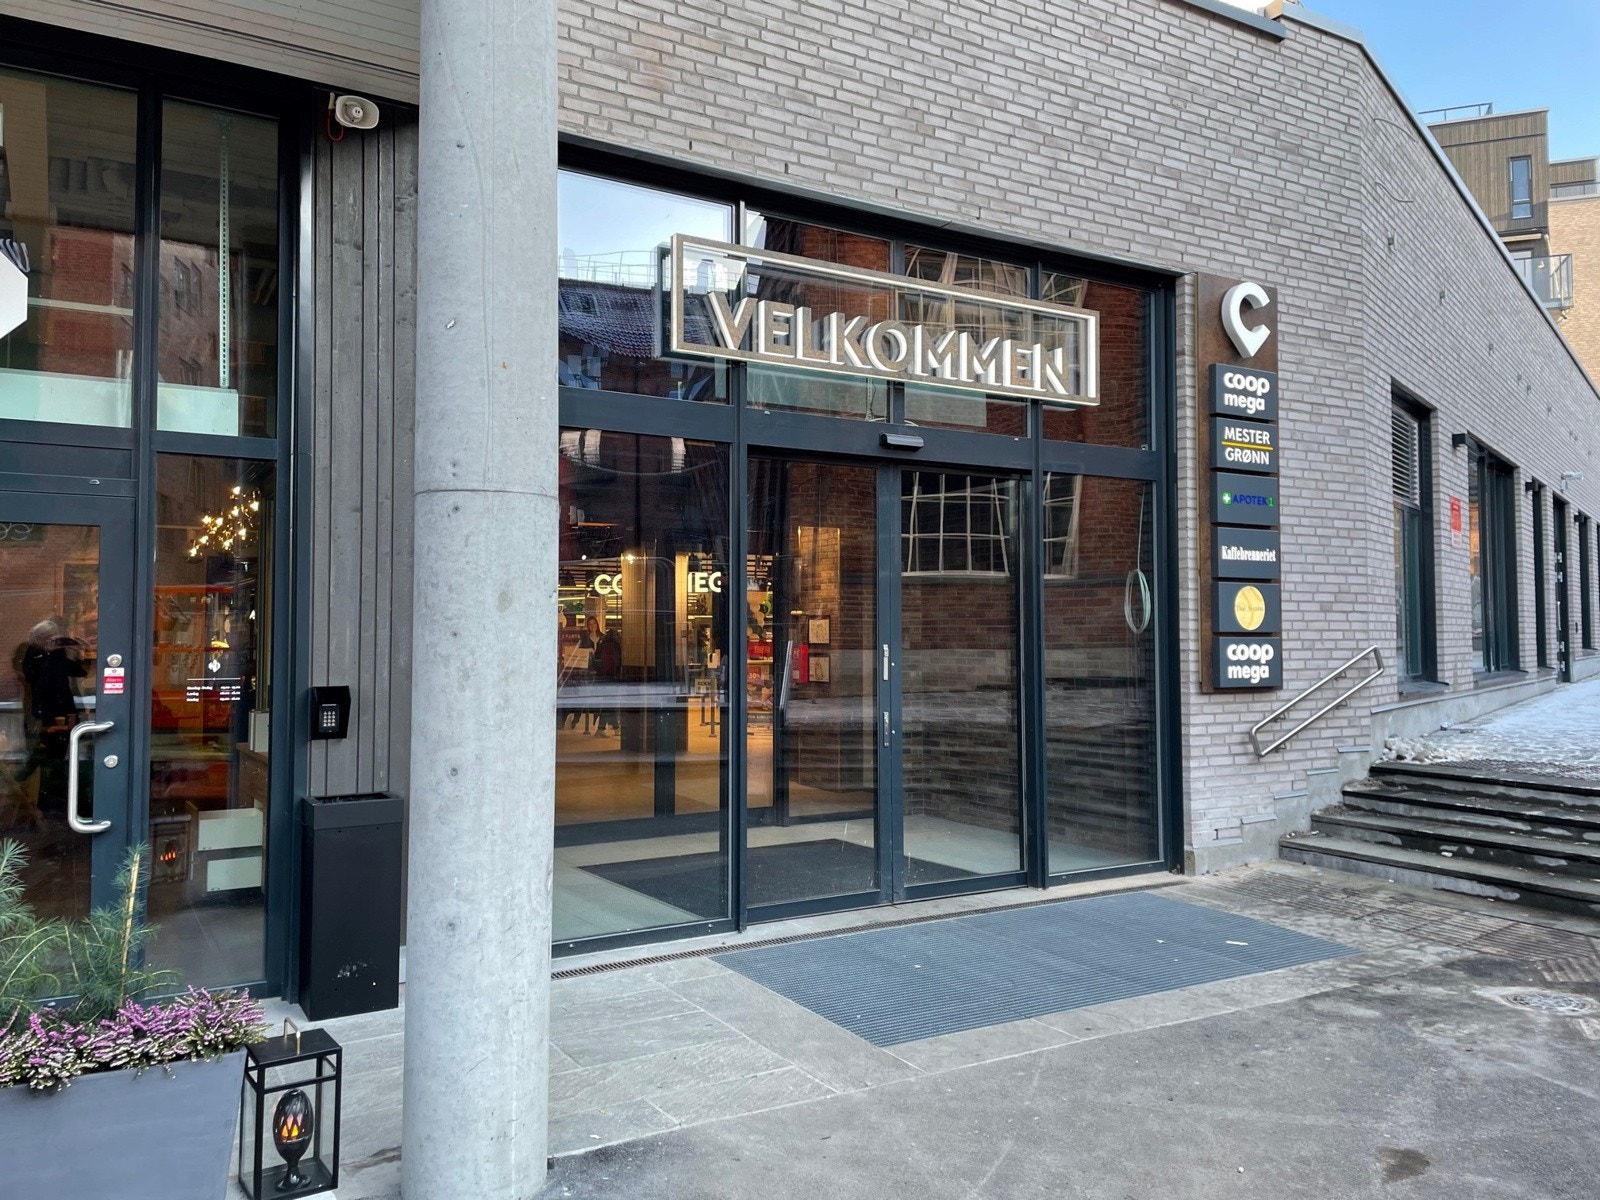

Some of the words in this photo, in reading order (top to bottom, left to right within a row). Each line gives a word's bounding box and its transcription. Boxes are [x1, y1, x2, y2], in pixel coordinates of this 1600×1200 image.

[704, 291, 1068, 396] VELKOMMEN
[1224, 373, 1270, 395] coop
[1224, 393, 1265, 413] mega
[1224, 426, 1271, 445] MESTER
[1225, 447, 1270, 465] GRØNN
[1227, 644, 1274, 663] coop
[1228, 665, 1269, 683] mega
